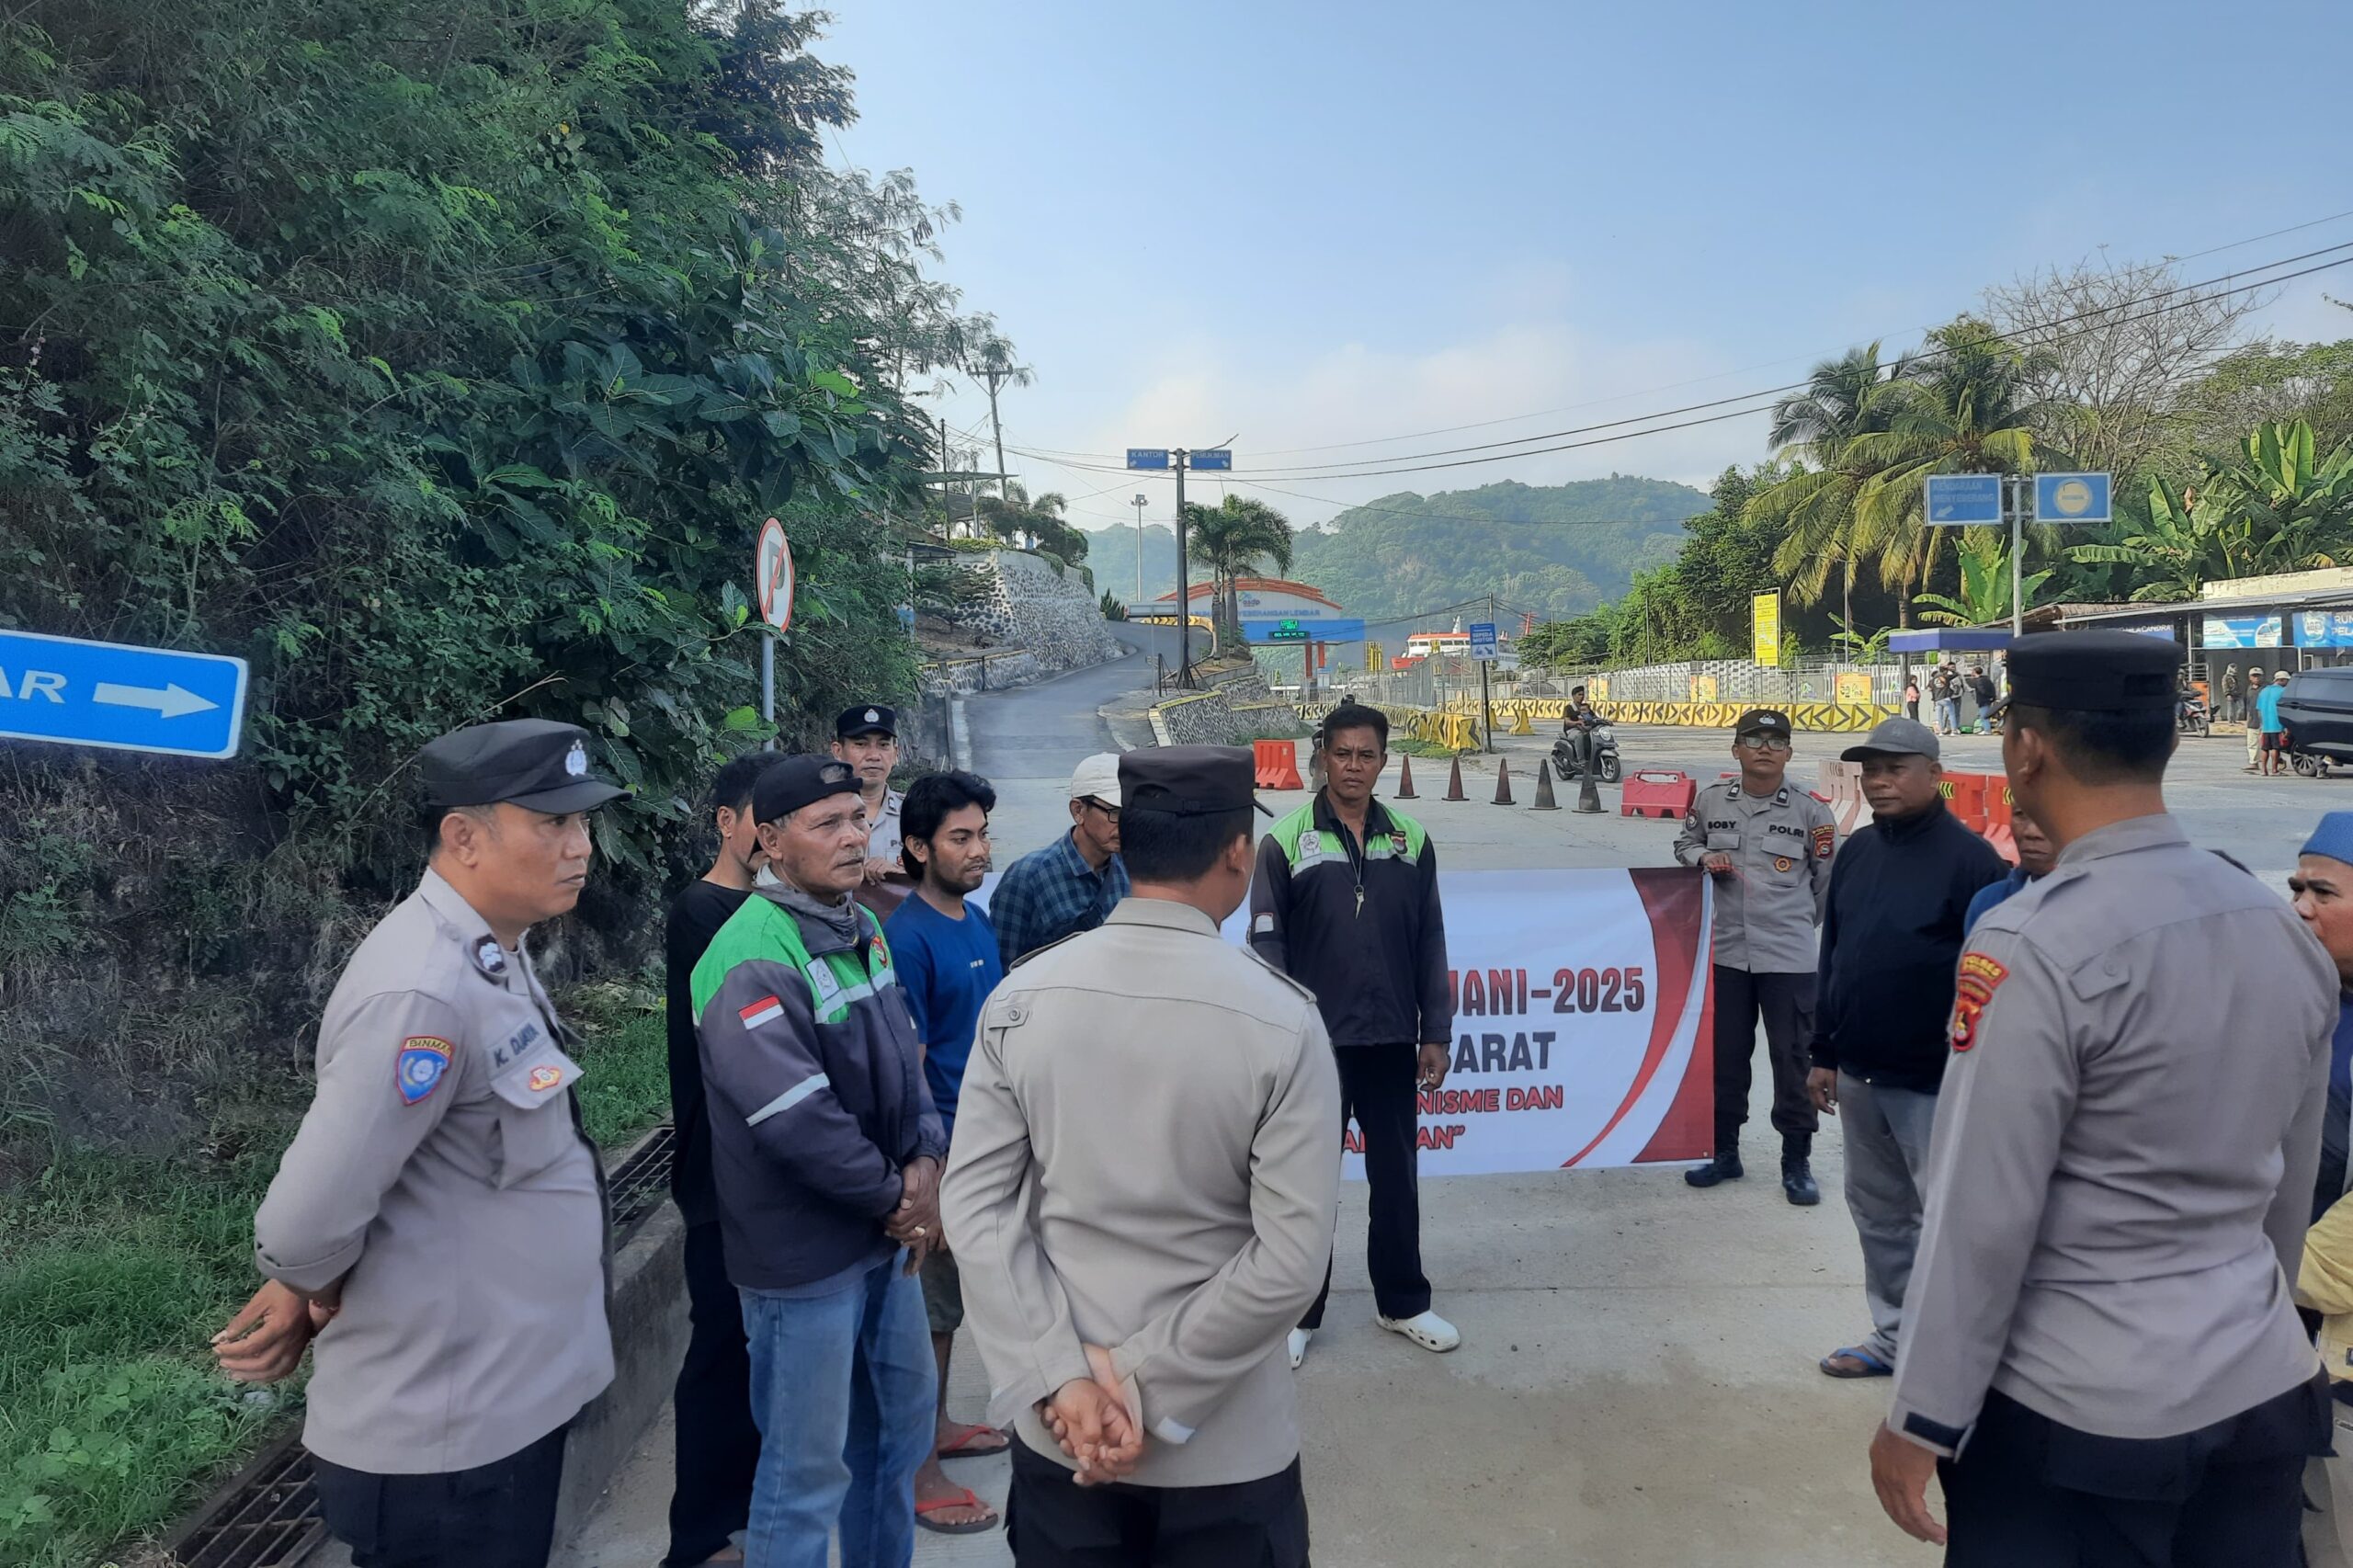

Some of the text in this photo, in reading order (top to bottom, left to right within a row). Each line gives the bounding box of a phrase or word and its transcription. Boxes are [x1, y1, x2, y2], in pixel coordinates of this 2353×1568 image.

[1131, 450, 1164, 459] KANTOR
[1708, 821, 1736, 829] BOBY
[1769, 824, 1804, 837] POLRI
[1448, 1031, 1556, 1074] ARAT
[1506, 1085, 1563, 1111] DAN
